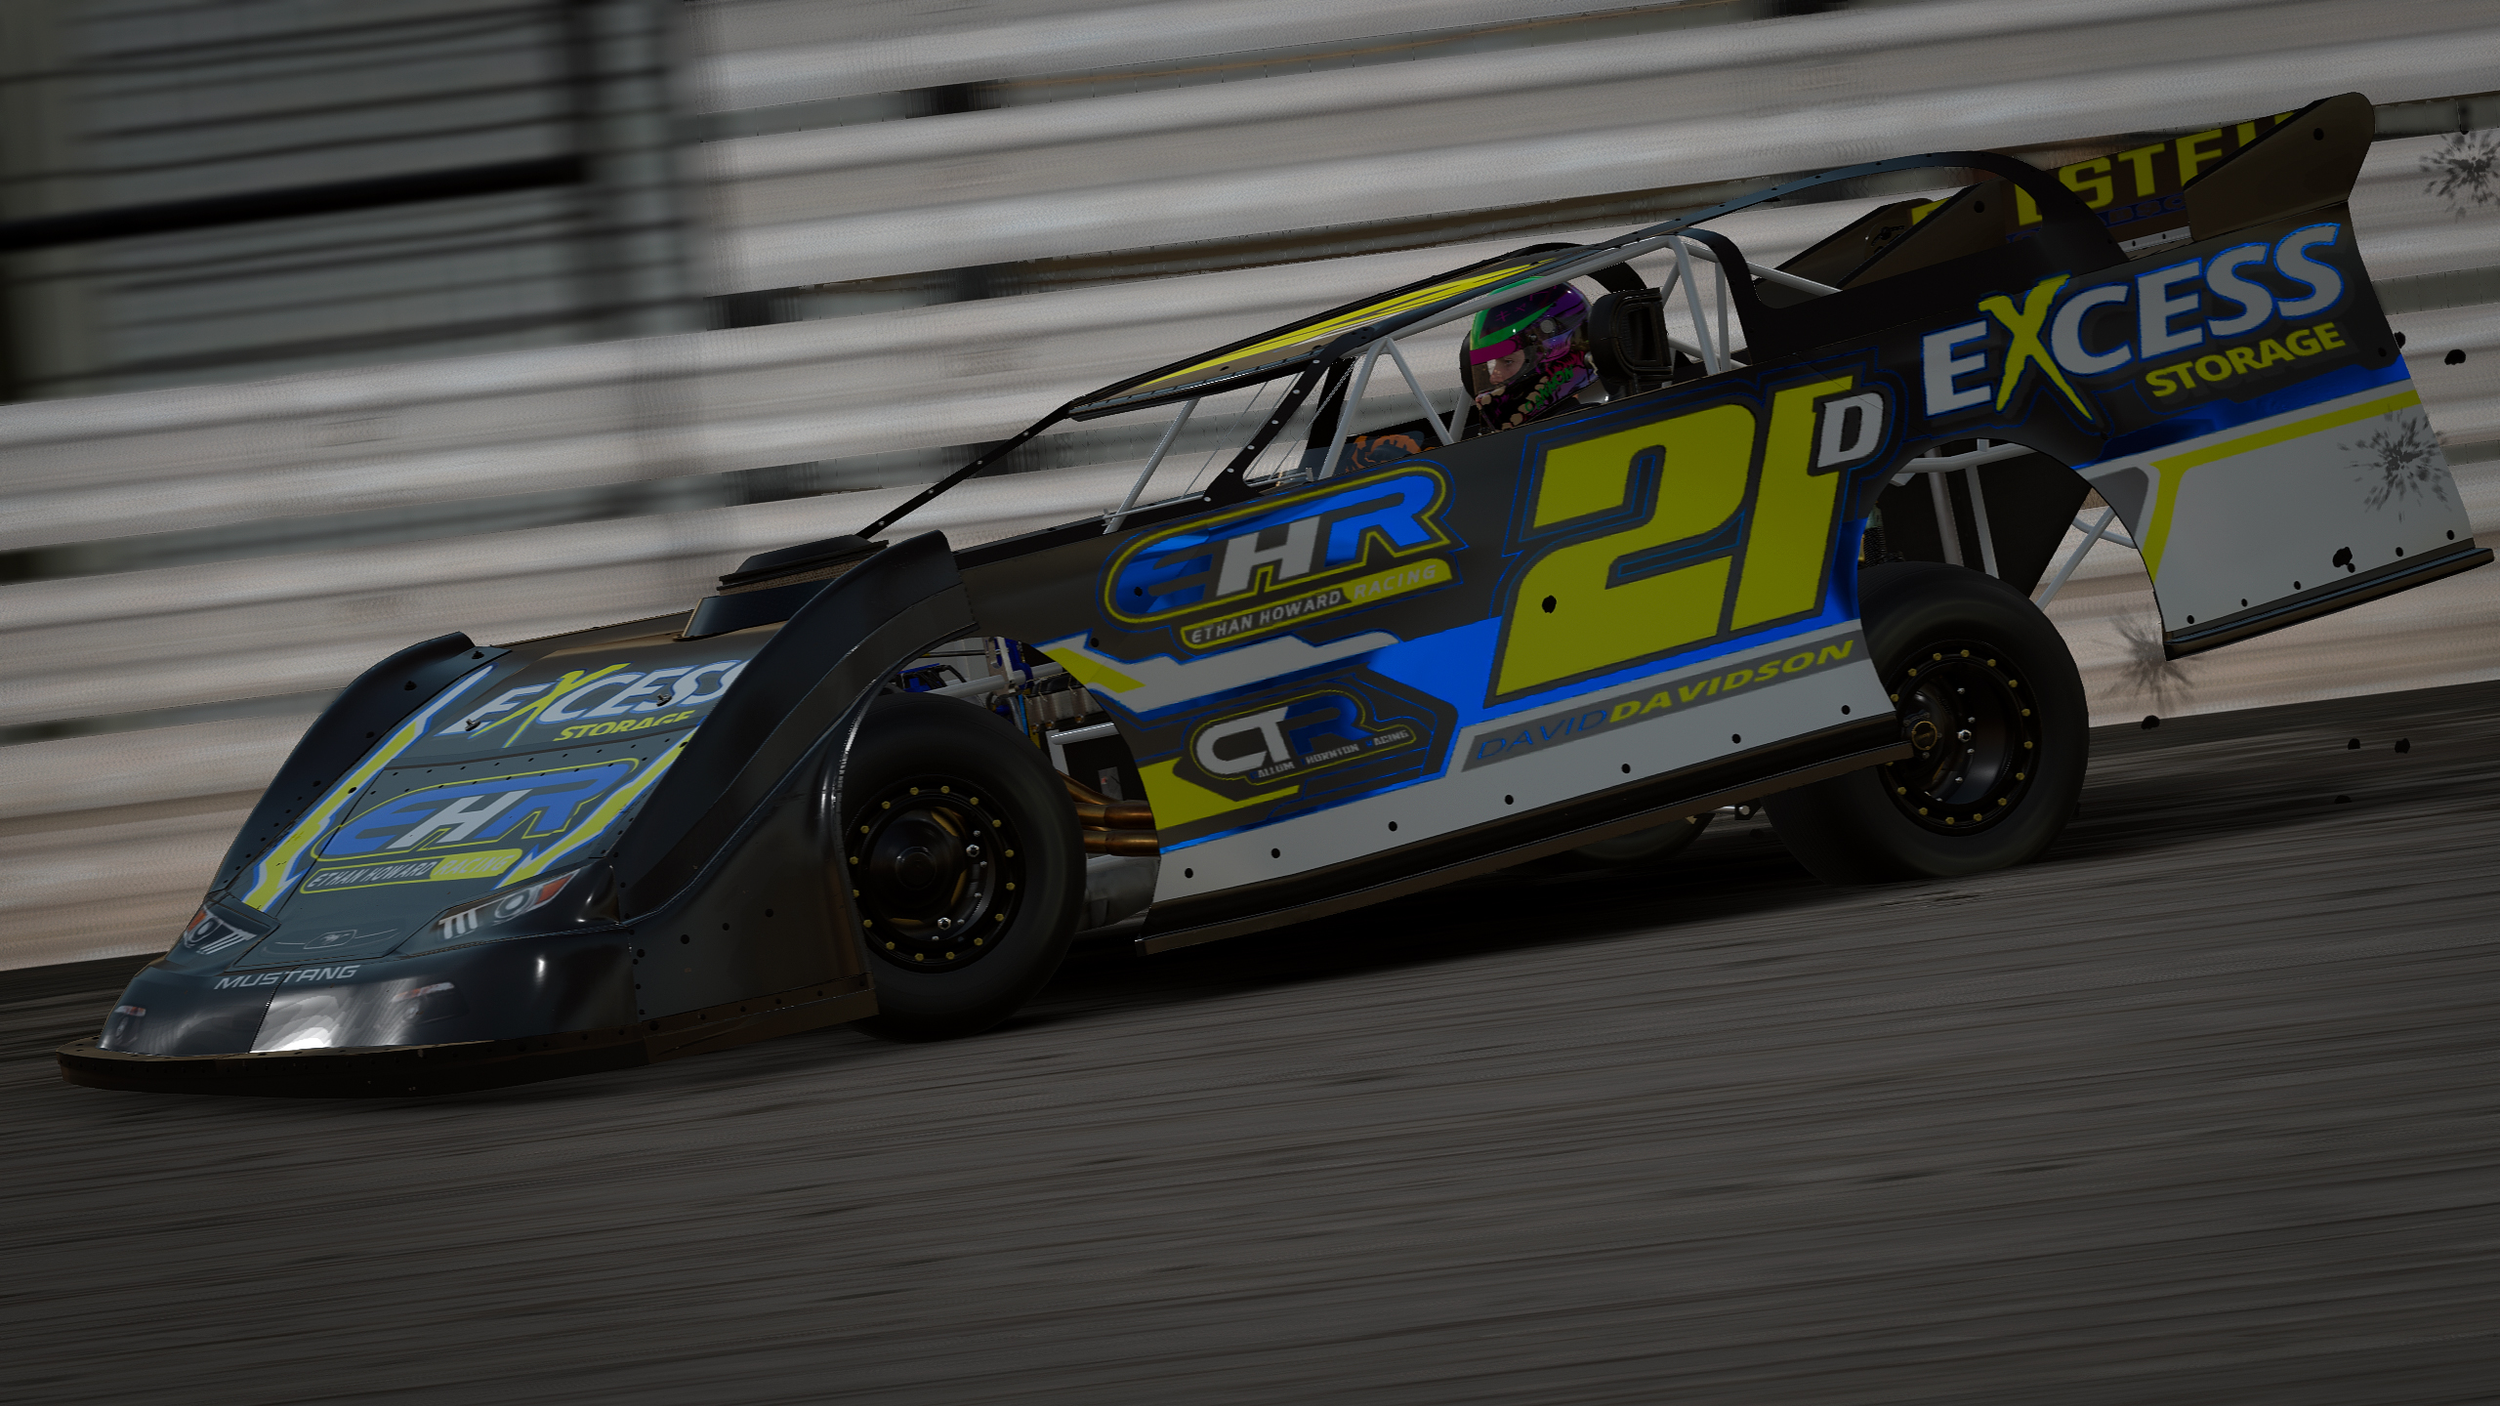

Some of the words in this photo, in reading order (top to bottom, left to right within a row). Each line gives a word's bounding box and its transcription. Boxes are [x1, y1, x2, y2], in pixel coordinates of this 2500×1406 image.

[1921, 222, 2345, 422] EXCESS
[2145, 321, 2346, 398] STORAGE
[1115, 474, 1433, 615] EHR
[1190, 613, 1254, 644] ETHAN
[1259, 590, 1342, 626] HOWARD
[1353, 564, 1438, 601] RACING
[552, 709, 697, 742] STORAGE
[1196, 694, 1375, 775] CTR
[306, 869, 364, 889] ETHAN
[362, 861, 439, 884] HOWARD
[434, 856, 511, 877] RACING
[213, 964, 361, 990] MUSTANG
